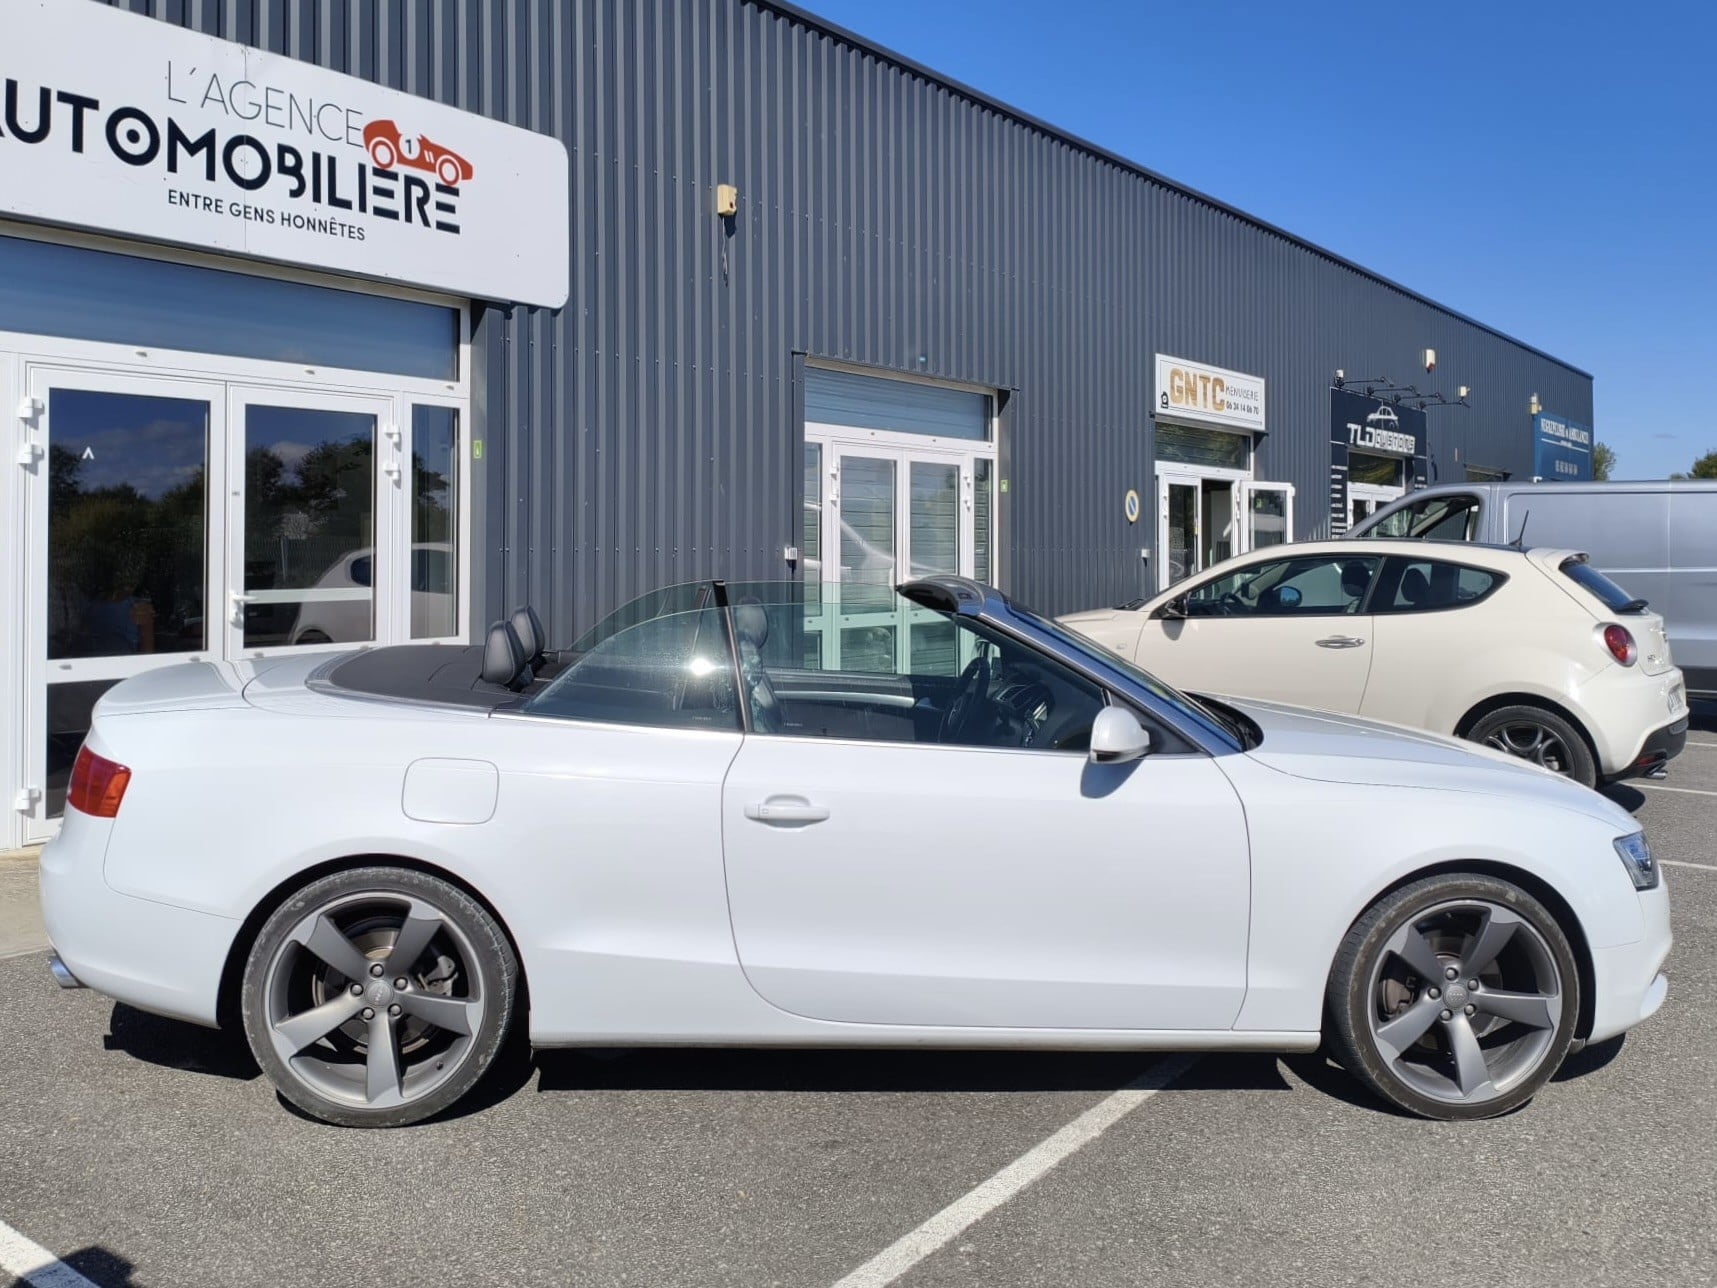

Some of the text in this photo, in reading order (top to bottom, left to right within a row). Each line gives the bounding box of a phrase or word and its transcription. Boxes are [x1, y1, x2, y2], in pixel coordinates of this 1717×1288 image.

[168, 60, 364, 148] L'AGENCE
[0, 78, 460, 235] UTOMOBILIERE
[405, 139, 413, 155] 1
[168, 189, 366, 241] ENTRE GENS HONNÊTES
[1169, 367, 1225, 412] GNTC
